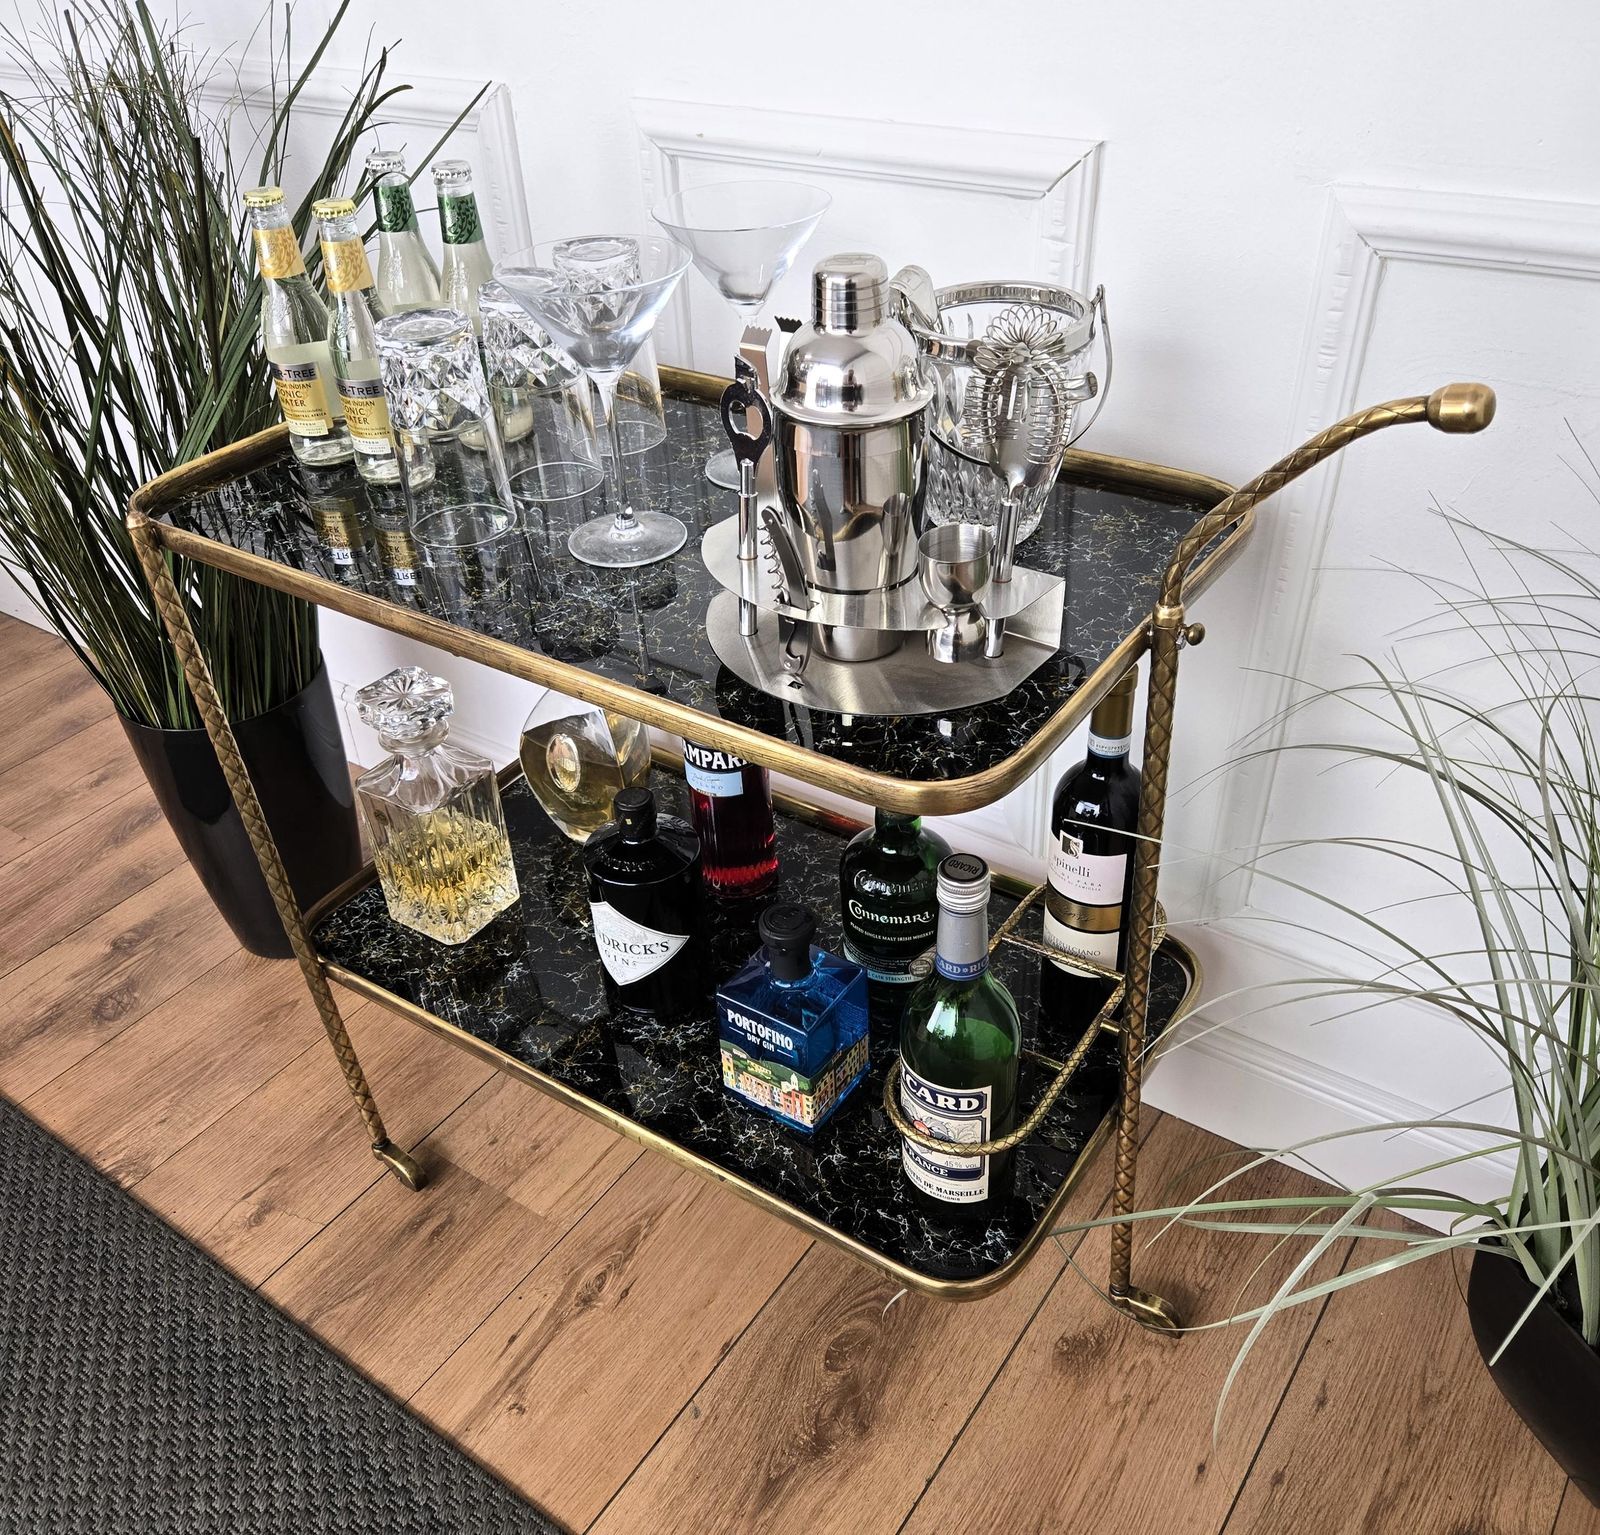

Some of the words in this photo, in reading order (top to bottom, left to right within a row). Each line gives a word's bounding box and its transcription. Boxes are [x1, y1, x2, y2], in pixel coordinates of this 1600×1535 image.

[343, 405, 366, 416] ONIC
[948, 860, 980, 874] RICARD
[848, 899, 935, 923] Connemara
[864, 930, 882, 940] SINGLE
[727, 1009, 793, 1051] PORTOFINO
[747, 1034, 761, 1045] DRY
[762, 1041, 775, 1052] GIN
[902, 1066, 980, 1111] CARD
[923, 1180, 934, 1190] DE
[936, 1187, 985, 1197] MARSEILLE
